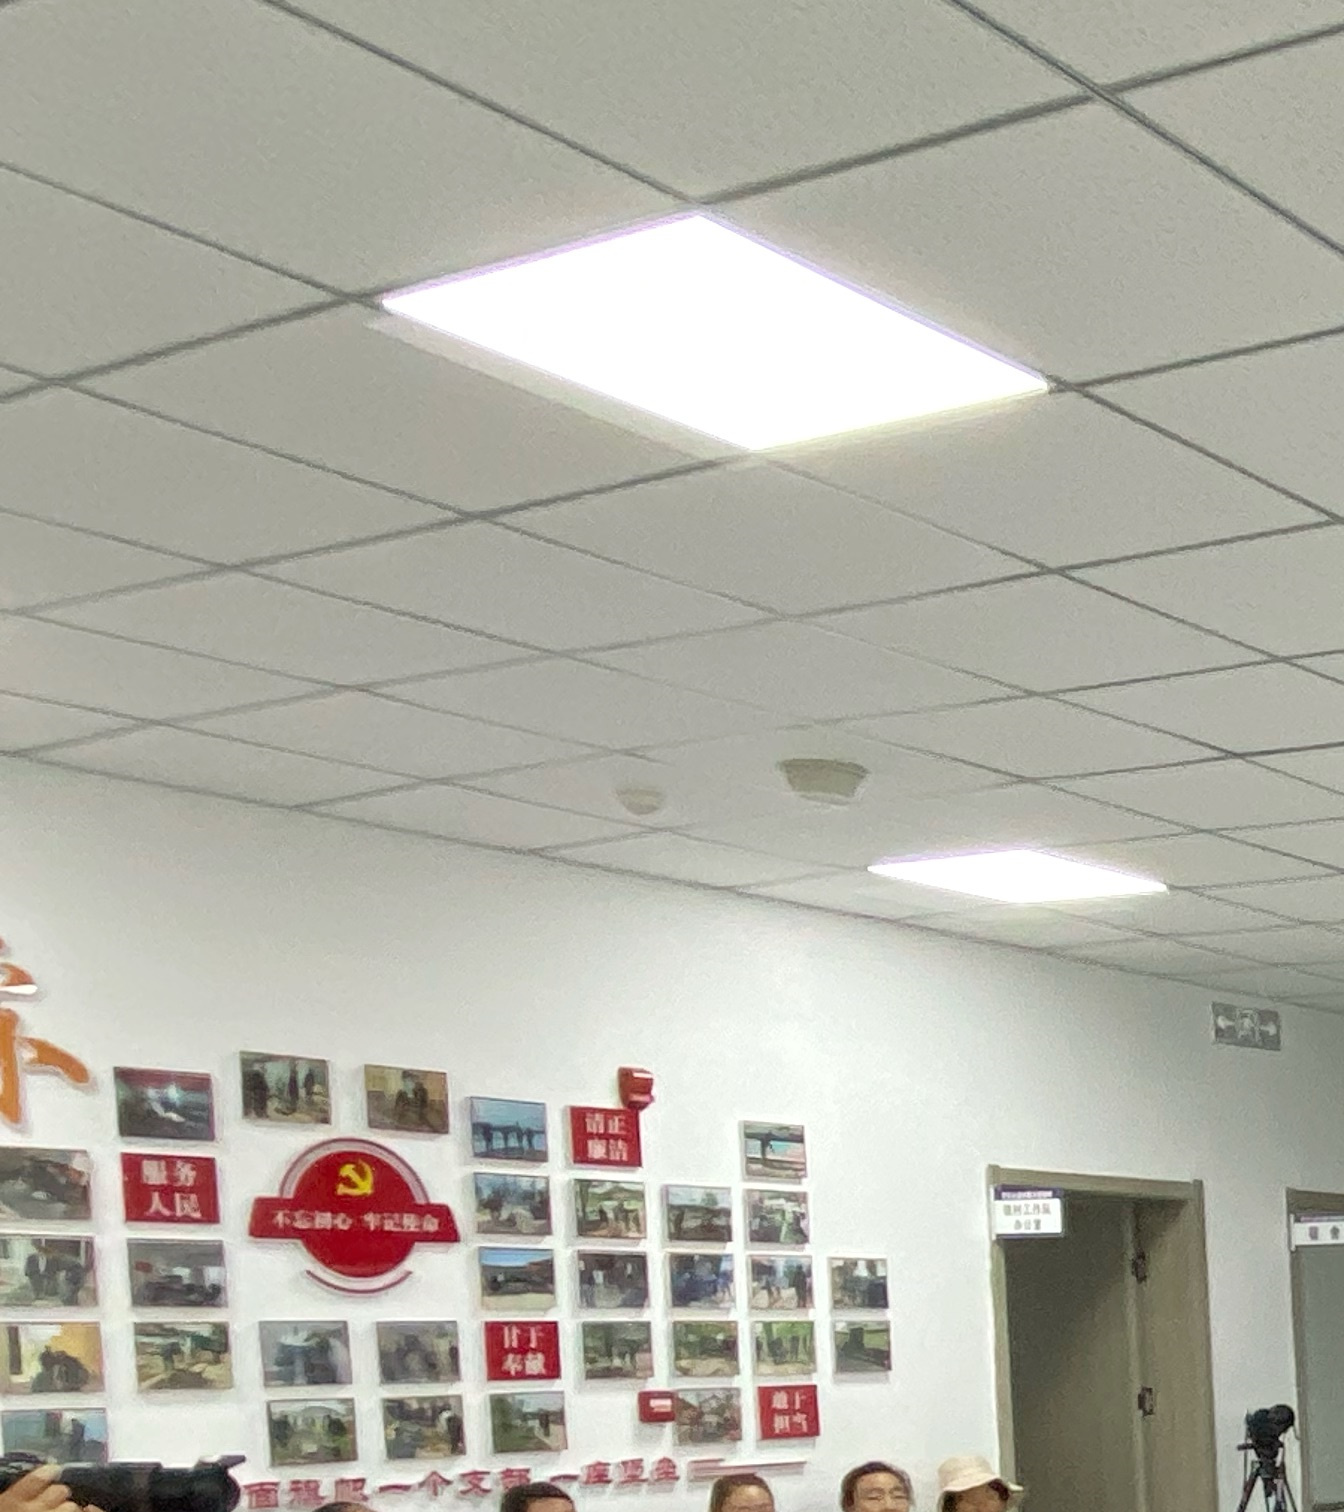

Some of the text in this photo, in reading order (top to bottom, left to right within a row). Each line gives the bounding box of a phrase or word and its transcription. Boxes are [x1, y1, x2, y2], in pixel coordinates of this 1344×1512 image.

[147, 1193, 203, 1219] 人民
[272, 1210, 353, 1231] 不忘初心
